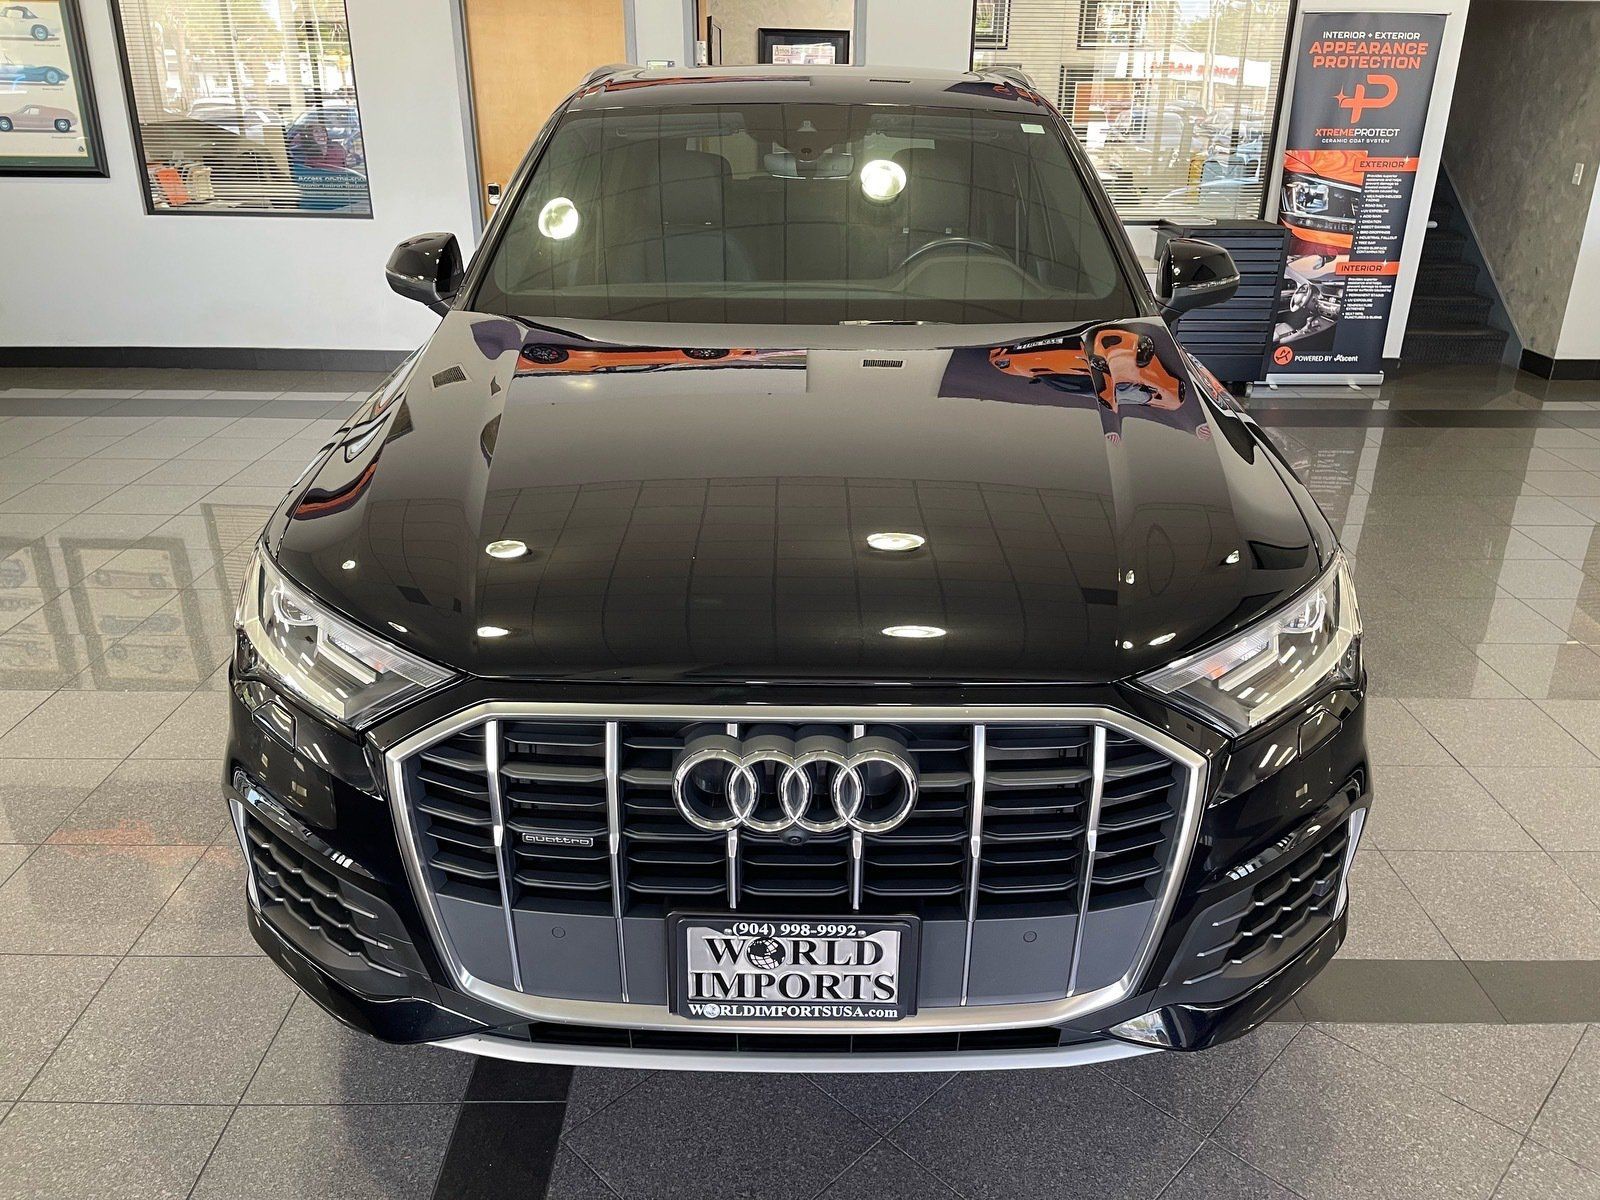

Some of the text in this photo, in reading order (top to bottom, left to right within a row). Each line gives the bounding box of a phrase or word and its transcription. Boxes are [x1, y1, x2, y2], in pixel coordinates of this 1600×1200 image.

[1374, 32, 1421, 40] EXTERIOR
[1309, 41, 1428, 55] APPEARANCE
[1312, 56, 1421, 69] PROTECTION
[1314, 128, 1400, 137] XTREMEPROTECT
[1359, 160, 1404, 168] EXTERIOR
[1334, 354, 1358, 362] Ascent
[525, 835, 590, 845] quattro
[732, 922, 857, 938] (904) 998-9992
[689, 971, 896, 1001] IMPORTS
